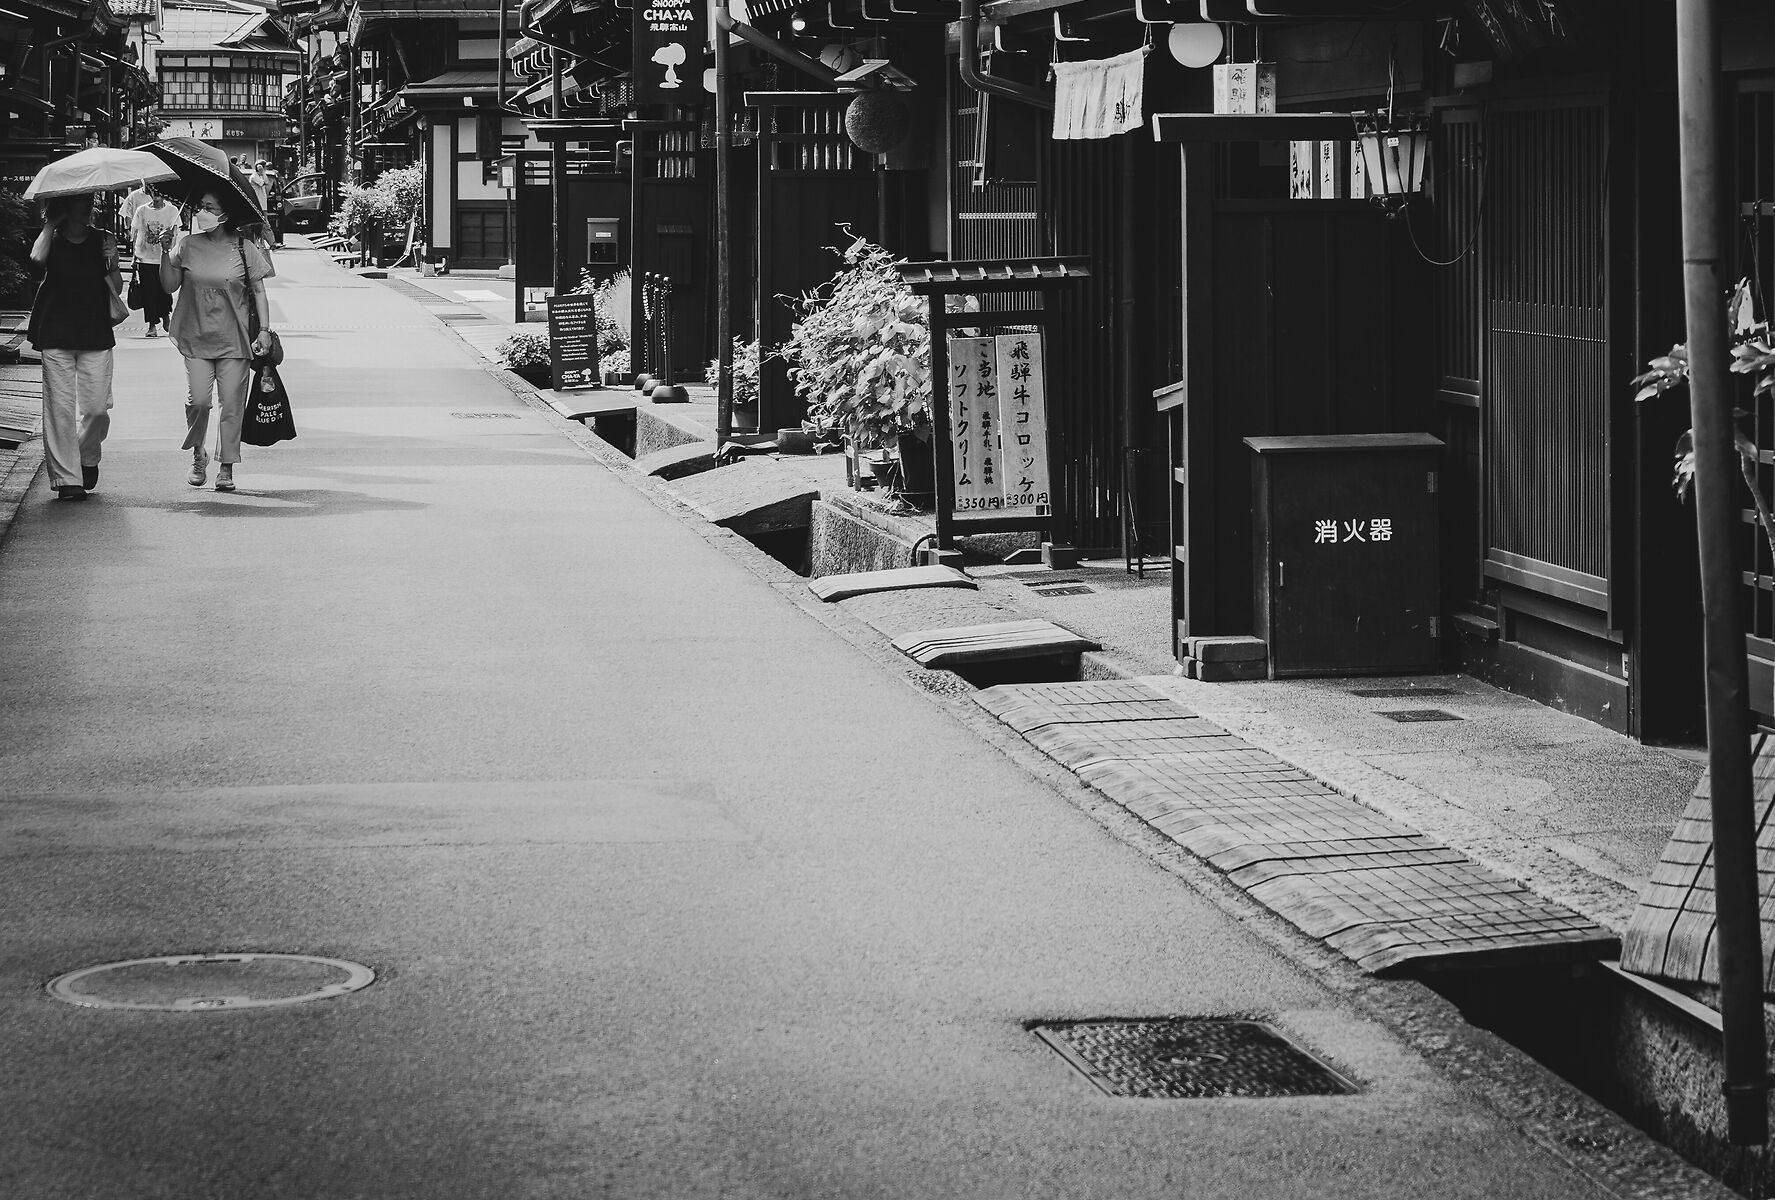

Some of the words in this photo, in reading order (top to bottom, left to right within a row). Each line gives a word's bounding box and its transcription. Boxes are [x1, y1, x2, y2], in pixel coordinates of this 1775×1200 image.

[643, 9, 694, 21] CHA-YA
[271, 412, 283, 422] DT
[954, 364, 972, 486] ソフトクリーム
[1010, 340, 1035, 493] 飛騨牛コロッケ
[1314, 518, 1393, 544] 消火器
